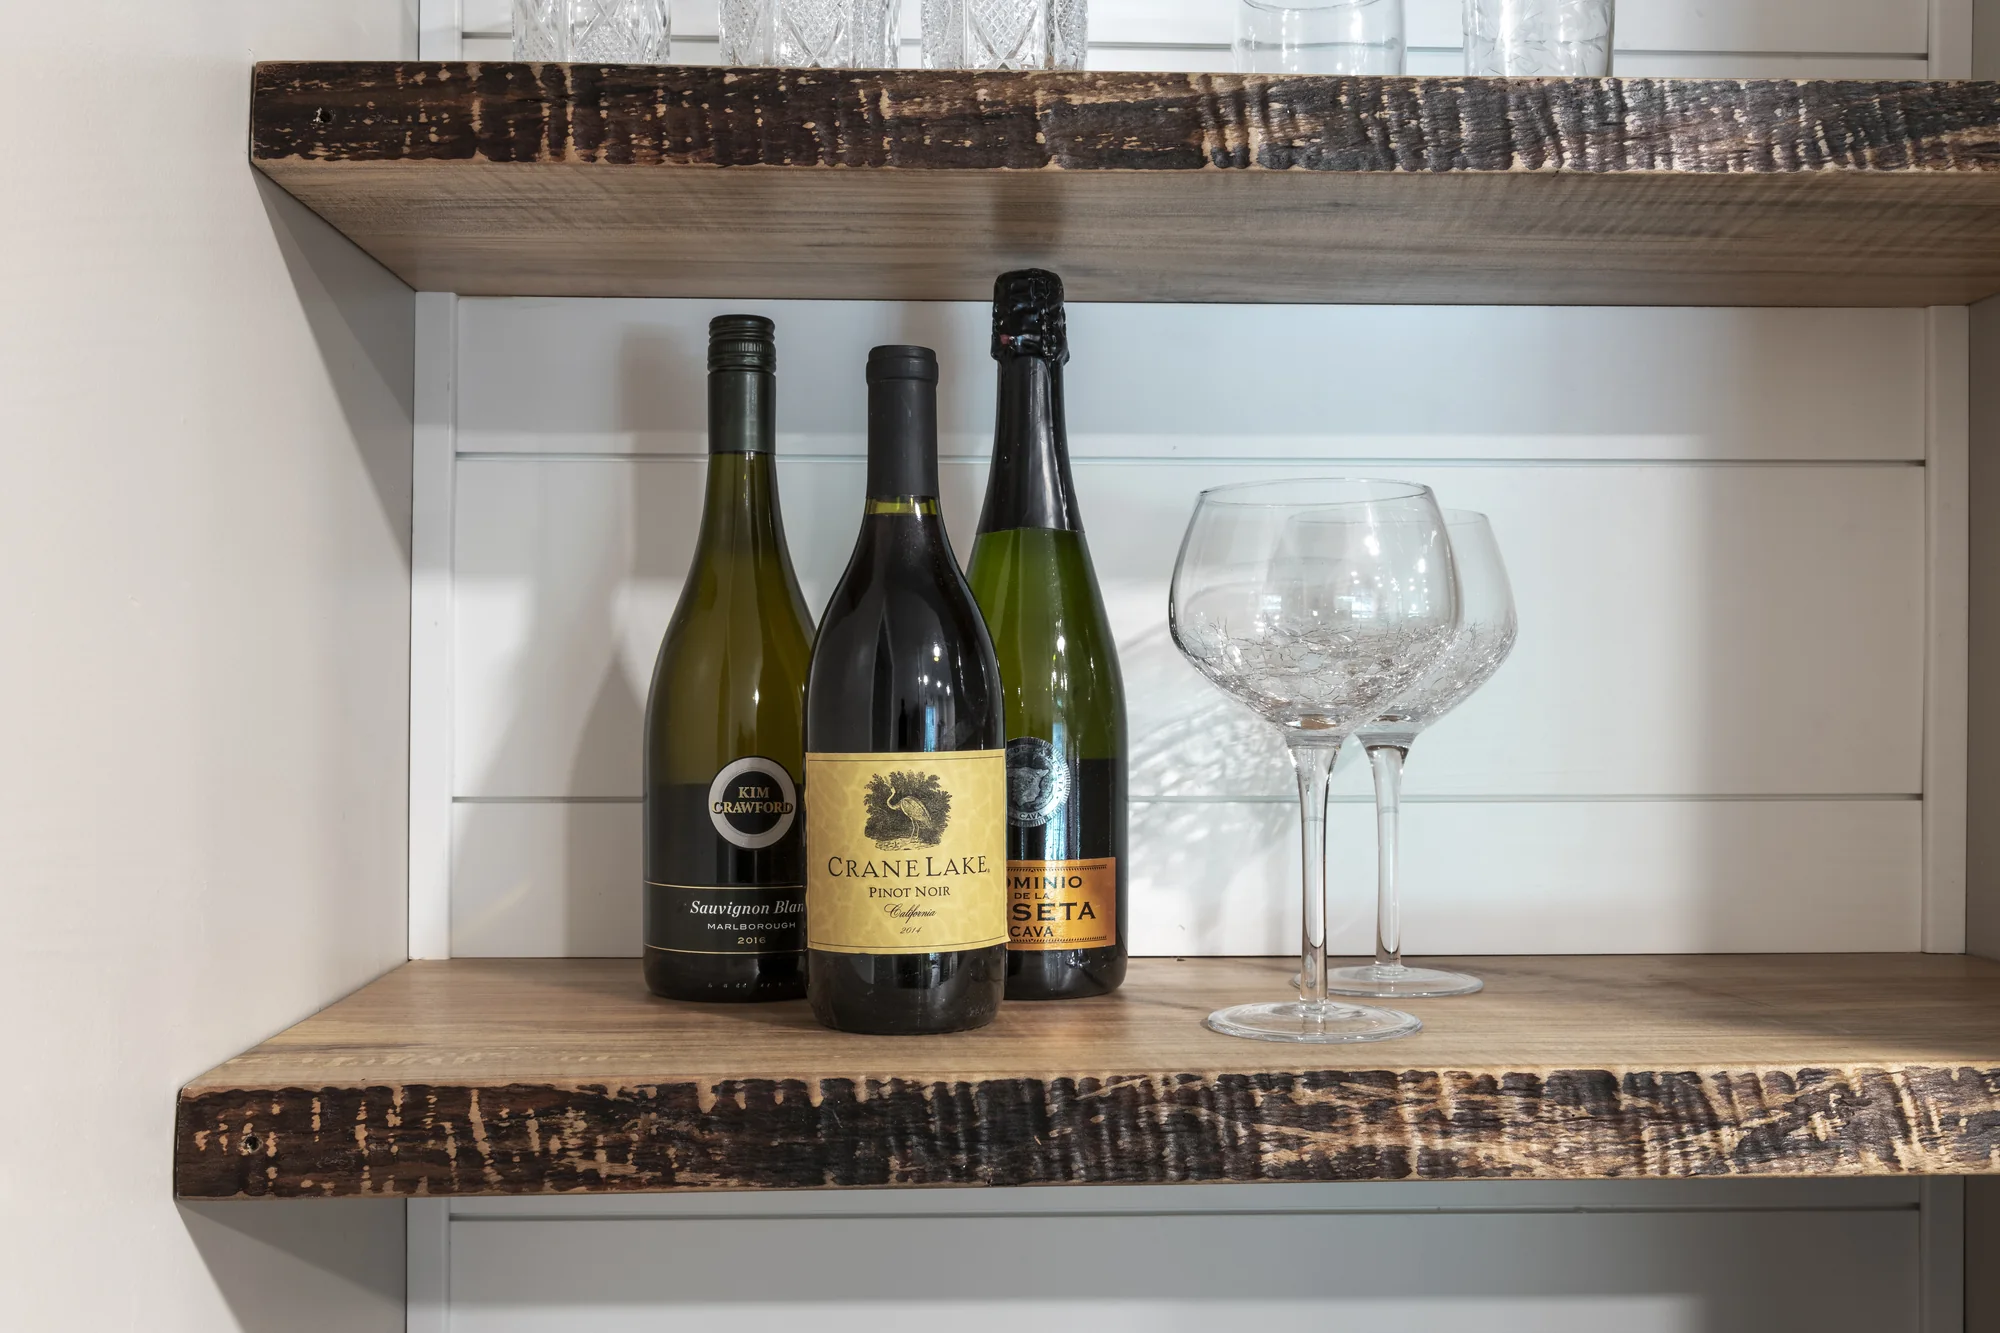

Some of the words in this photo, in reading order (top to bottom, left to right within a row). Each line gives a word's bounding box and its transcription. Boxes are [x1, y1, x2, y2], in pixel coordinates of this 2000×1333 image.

[738, 786, 770, 799] KIM
[711, 801, 793, 815] CRAWFORD
[1020, 811, 1042, 820] CAVA
[828, 856, 919, 878] CRANE
[925, 855, 988, 877] LAKE
[1007, 875, 1083, 889] MINIO
[869, 886, 911, 898] PINOT
[915, 886, 950, 898] NOIR
[1014, 892, 1030, 900] DE
[1034, 892, 1050, 900] LA
[690, 900, 770, 918] Sauvignon
[773, 900, 804, 915] Blan
[884, 903, 936, 923] California
[707, 922, 796, 931] MARLBOROUGH
[900, 926, 922, 935] 2014
[1010, 926, 1054, 937] CAVA
[737, 936, 766, 945] 2016
